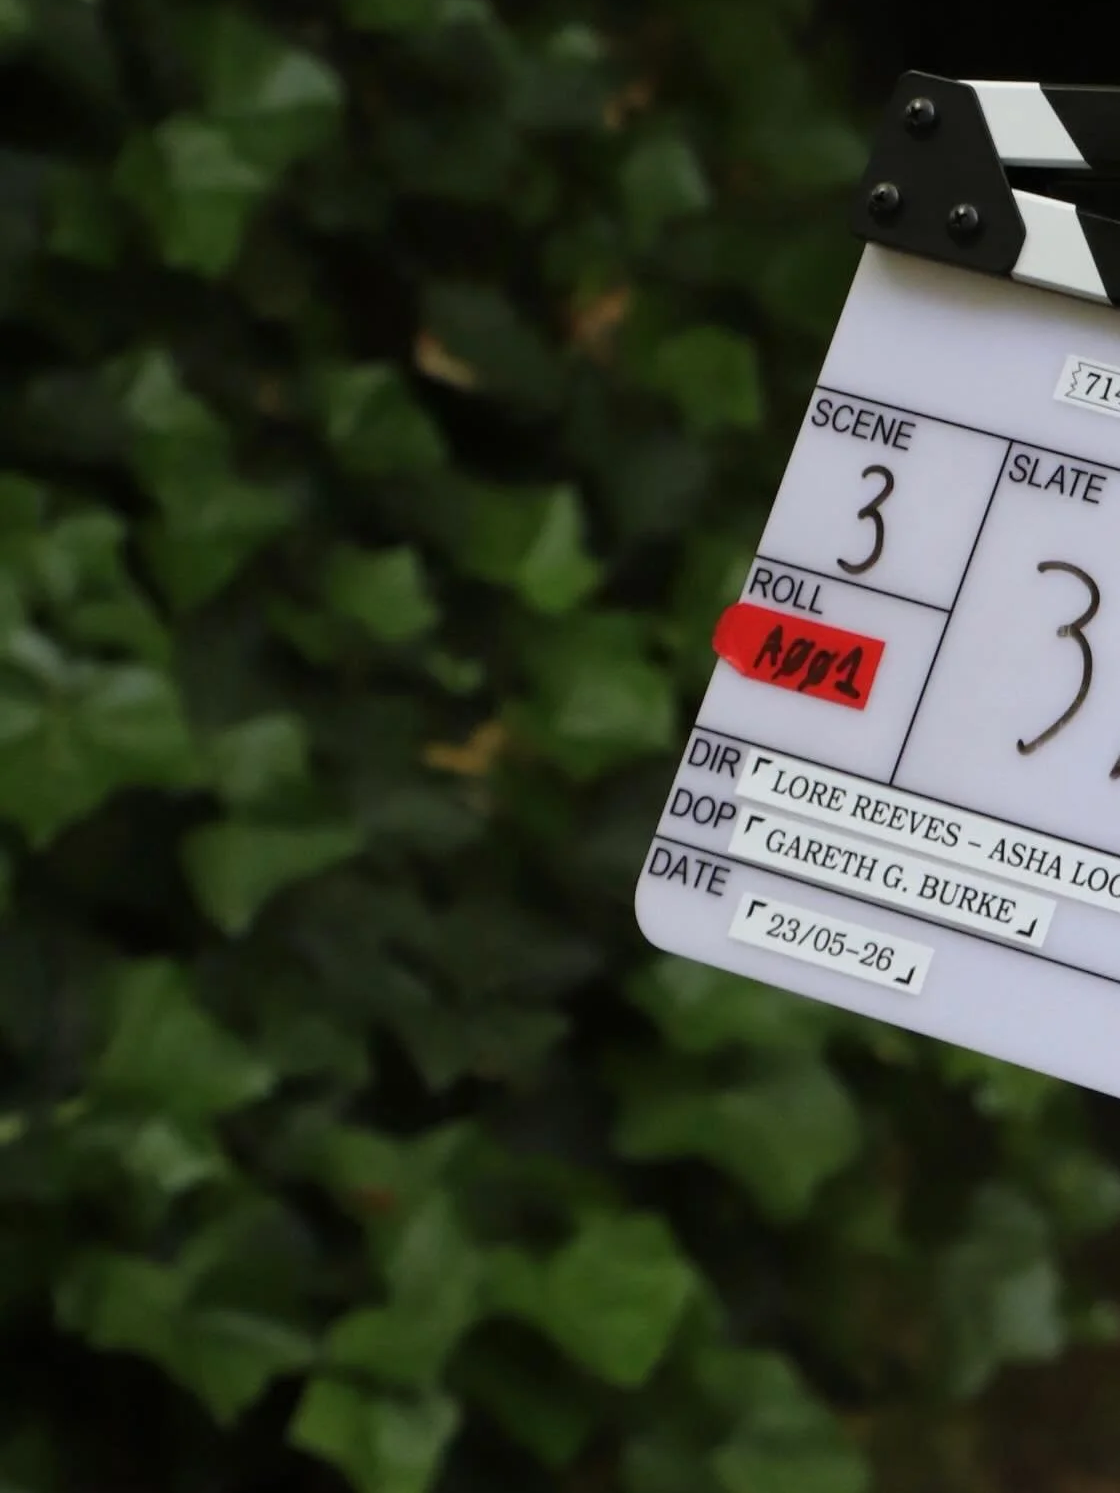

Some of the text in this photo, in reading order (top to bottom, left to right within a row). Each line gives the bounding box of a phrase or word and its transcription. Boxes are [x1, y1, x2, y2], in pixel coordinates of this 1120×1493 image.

[811, 398, 916, 451] SCENE
[1008, 453, 1107, 504] SLATE
[837, 464, 894, 575] 3
[749, 567, 823, 615] ROLL
[688, 738, 741, 778] DIR
[669, 788, 737, 828] DOP
[771, 770, 846, 812] LORE
[851, 794, 961, 848] REEVES
[988, 838, 1064, 880] ASHA
[648, 847, 731, 897] DATE
[765, 829, 1017, 924] GARETH G. BURKE
